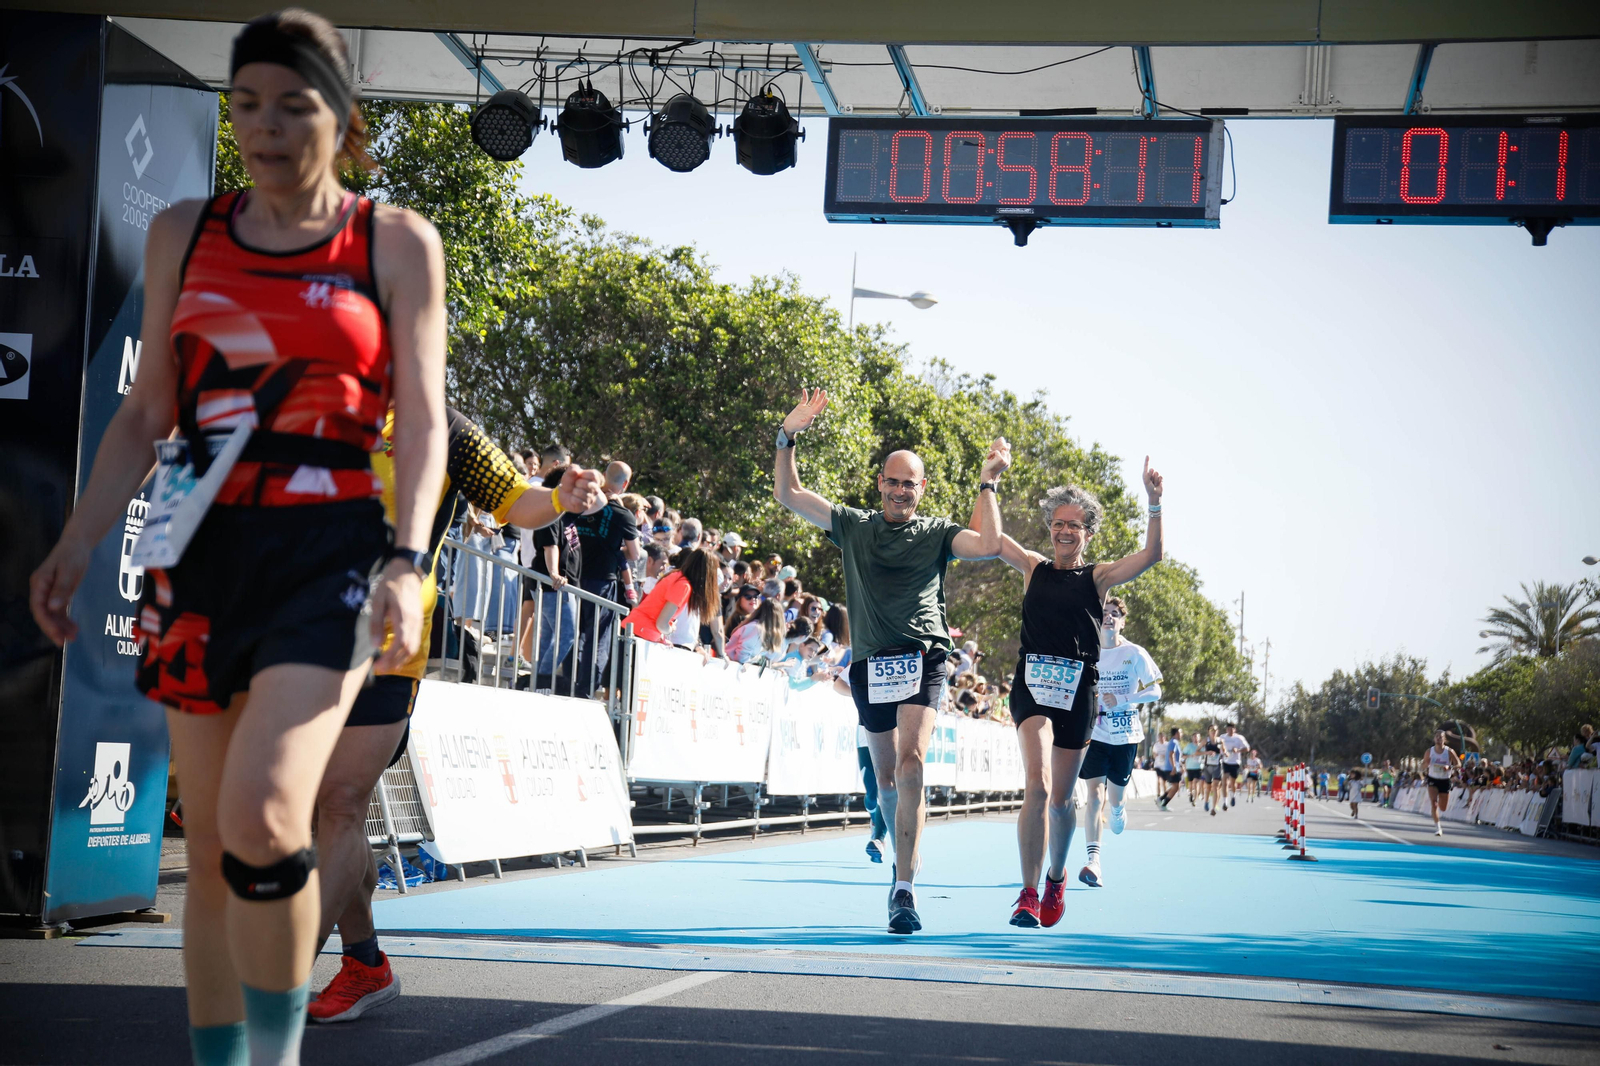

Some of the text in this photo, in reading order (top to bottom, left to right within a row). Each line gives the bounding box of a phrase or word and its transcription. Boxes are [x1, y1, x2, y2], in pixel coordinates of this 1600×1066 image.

[122, 181, 171, 214] COOPER
[122, 203, 149, 231] 2005
[116, 640, 143, 656] CIUDAD
[874, 659, 918, 677] 5536
[1030, 663, 1077, 684] 5535
[1040, 678, 1062, 686] ENCARNI
[438, 727, 493, 769] ALMERÍA
[445, 777, 477, 799] CIUDAD
[87, 835, 121, 847] DEPORTES
[120, 834, 129, 845] DE
